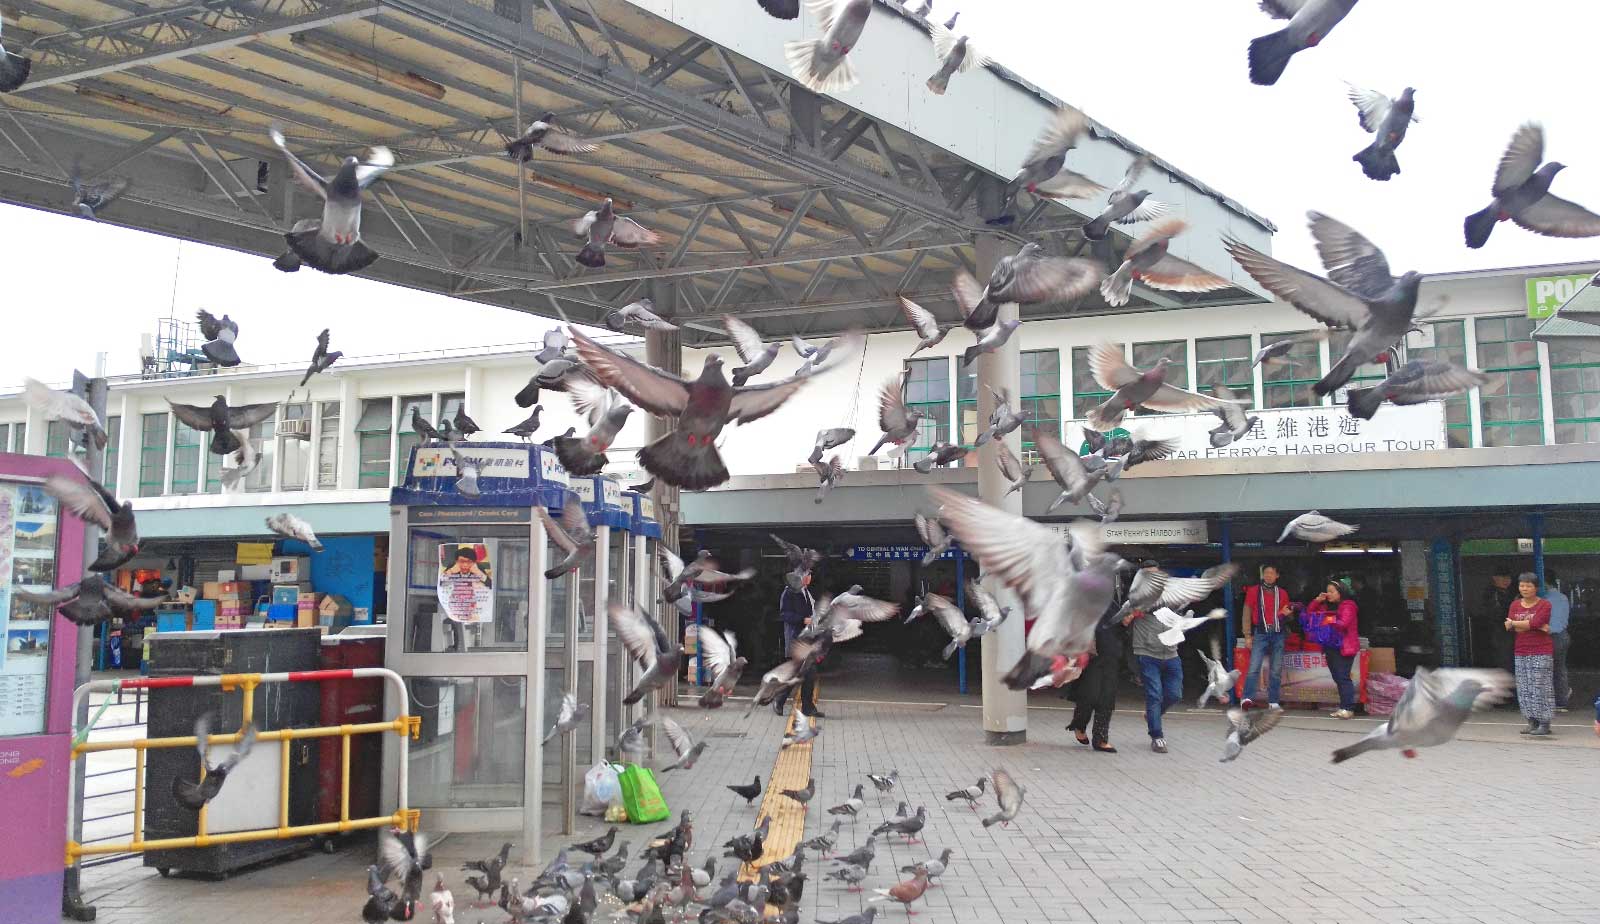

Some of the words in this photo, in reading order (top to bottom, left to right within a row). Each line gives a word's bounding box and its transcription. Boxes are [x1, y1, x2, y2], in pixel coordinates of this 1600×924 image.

[1205, 445, 1278, 459] FERRY'S
[1285, 442, 1376, 455] HARBOUR
[1383, 439, 1436, 452] TOUR
[1106, 529, 1123, 537] STAR
[1150, 528, 1182, 537] HARBOUR
